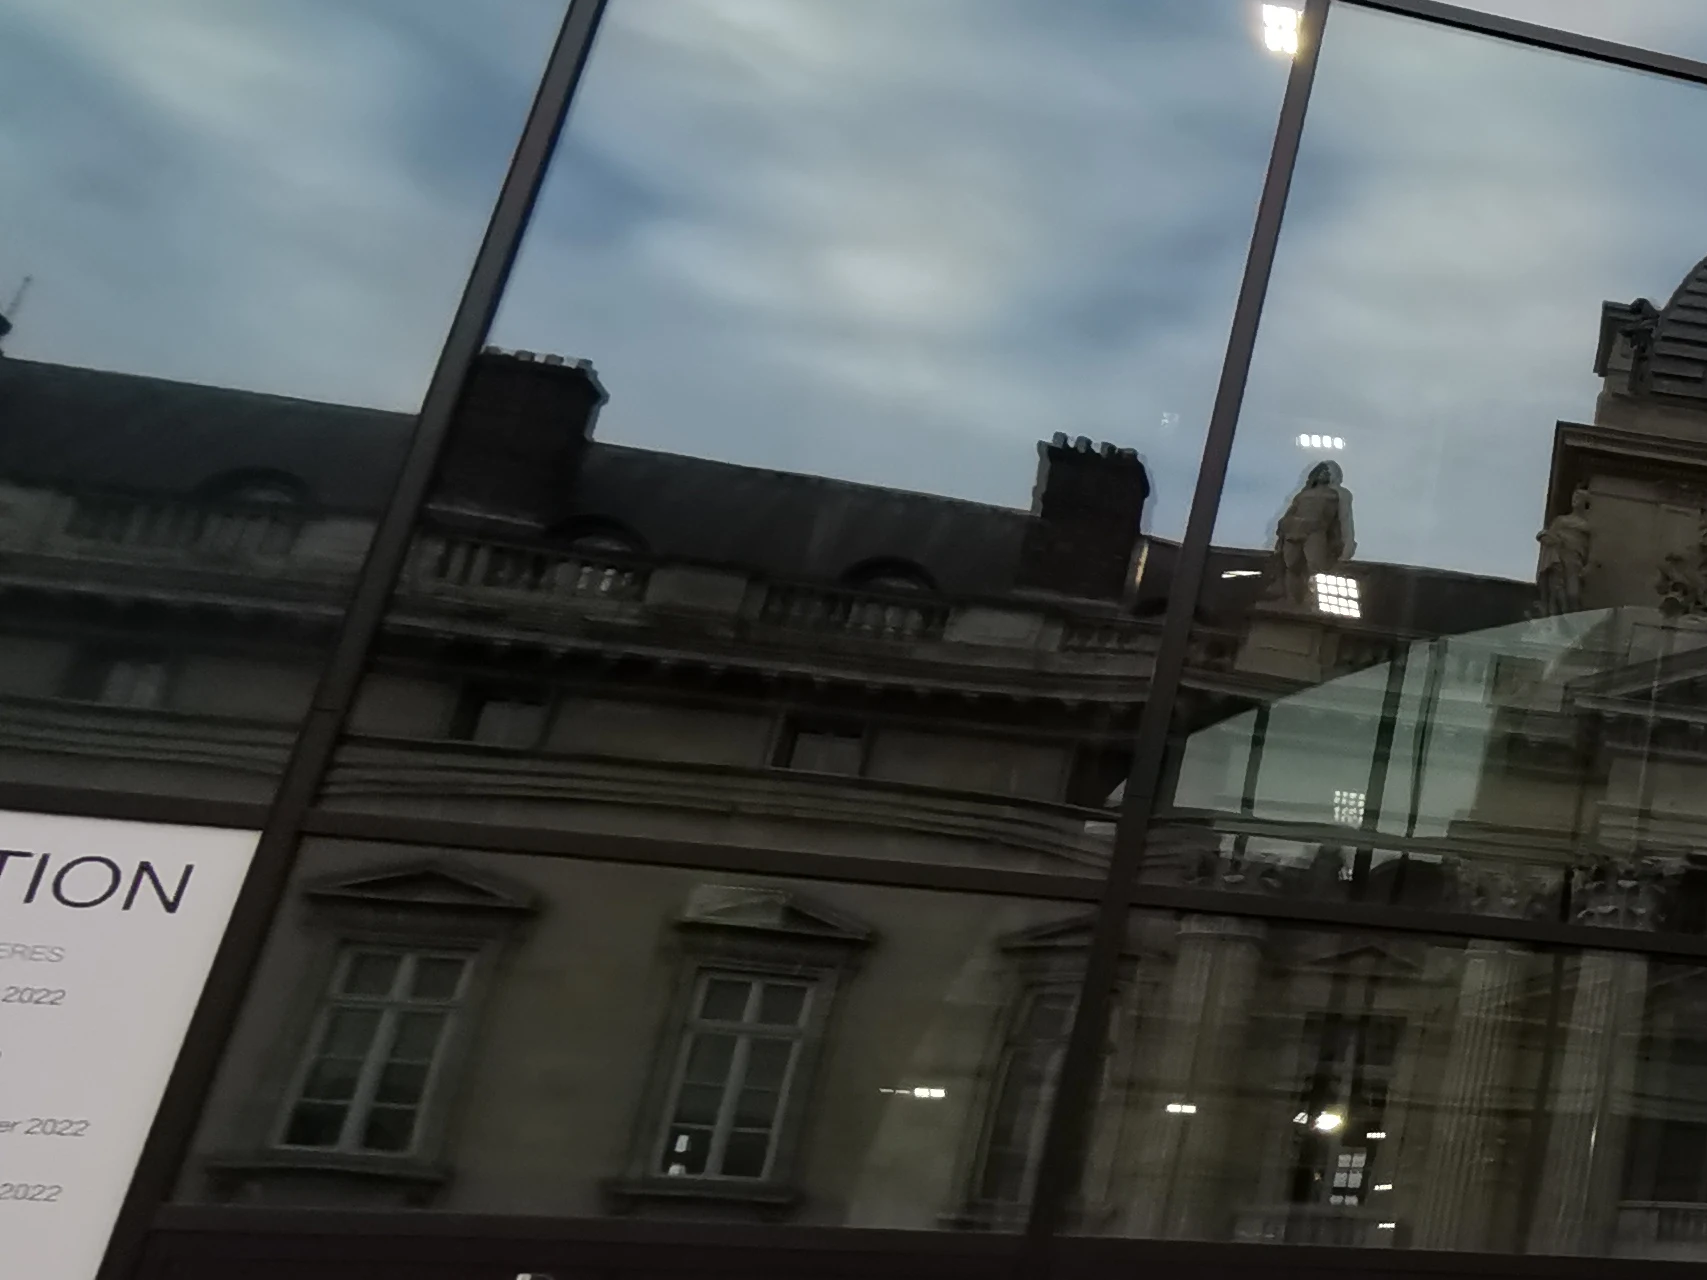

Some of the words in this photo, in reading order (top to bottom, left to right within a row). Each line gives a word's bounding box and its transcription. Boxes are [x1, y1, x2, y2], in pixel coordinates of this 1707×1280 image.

[2, 986, 66, 1006] 2022
[24, 1117, 91, 1136] 2022
[0, 1182, 63, 1202] 2022
